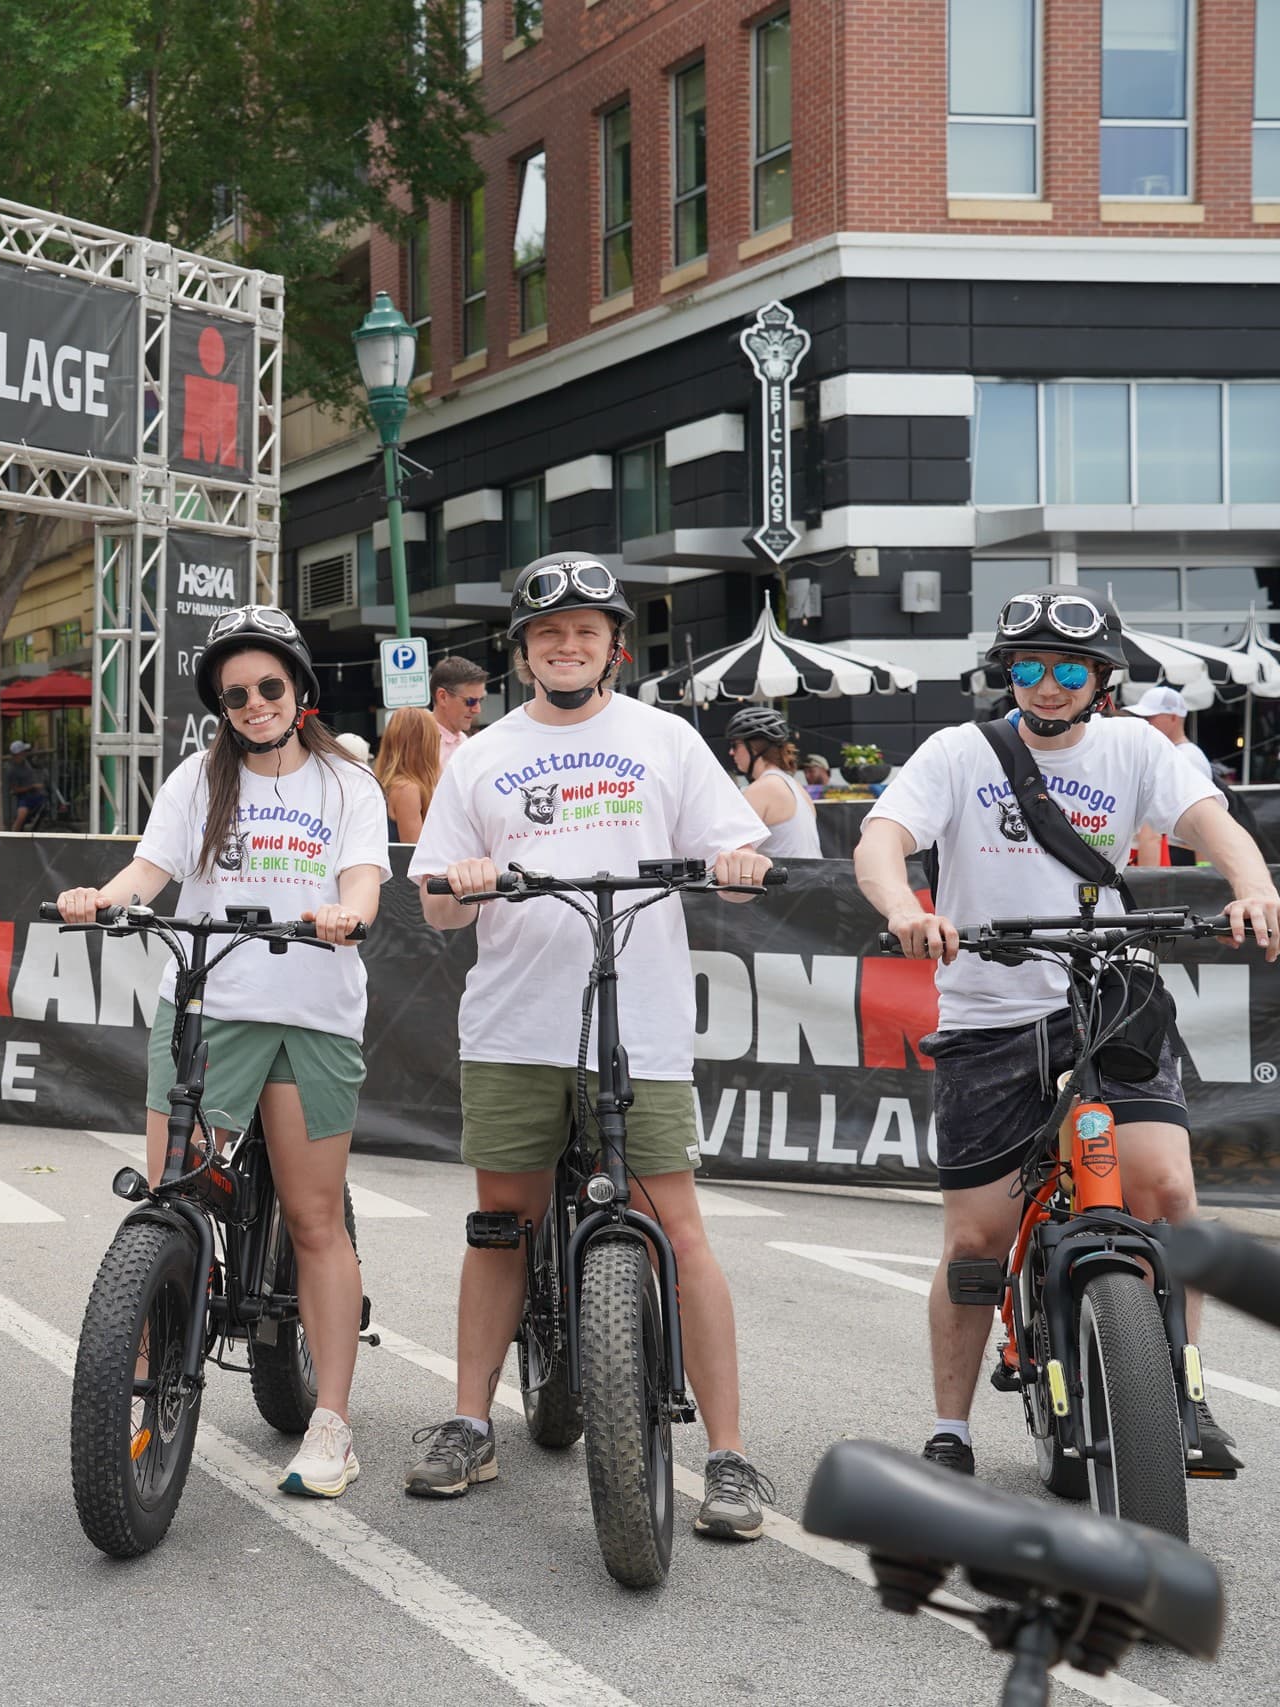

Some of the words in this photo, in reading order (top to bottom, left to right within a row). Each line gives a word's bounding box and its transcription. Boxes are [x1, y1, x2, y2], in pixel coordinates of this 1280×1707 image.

[770, 386, 782, 443] EPIC
[770, 450, 784, 523] TACOS
[178, 562, 235, 600] HOKA
[494, 752, 646, 796] Chattanooga
[561, 783, 594, 802] Wild
[598, 779, 636, 799] Hogs
[977, 774, 1116, 813] Chanooga
[562, 802, 600, 821] E-BIKE
[605, 800, 644, 815] TOURS
[1070, 811, 1108, 833] Hogs
[507, 831, 529, 841] ALL
[534, 825, 580, 837] WHEELS
[586, 819, 641, 830] ELECTRIC
[252, 835, 283, 851] Wild
[288, 836, 322, 859] Hogs
[250, 856, 288, 871] E-BIKE
[294, 857, 327, 877] TOURS
[221, 875, 266, 884] WHEELS
[692, 1086, 938, 1169] VILLA
